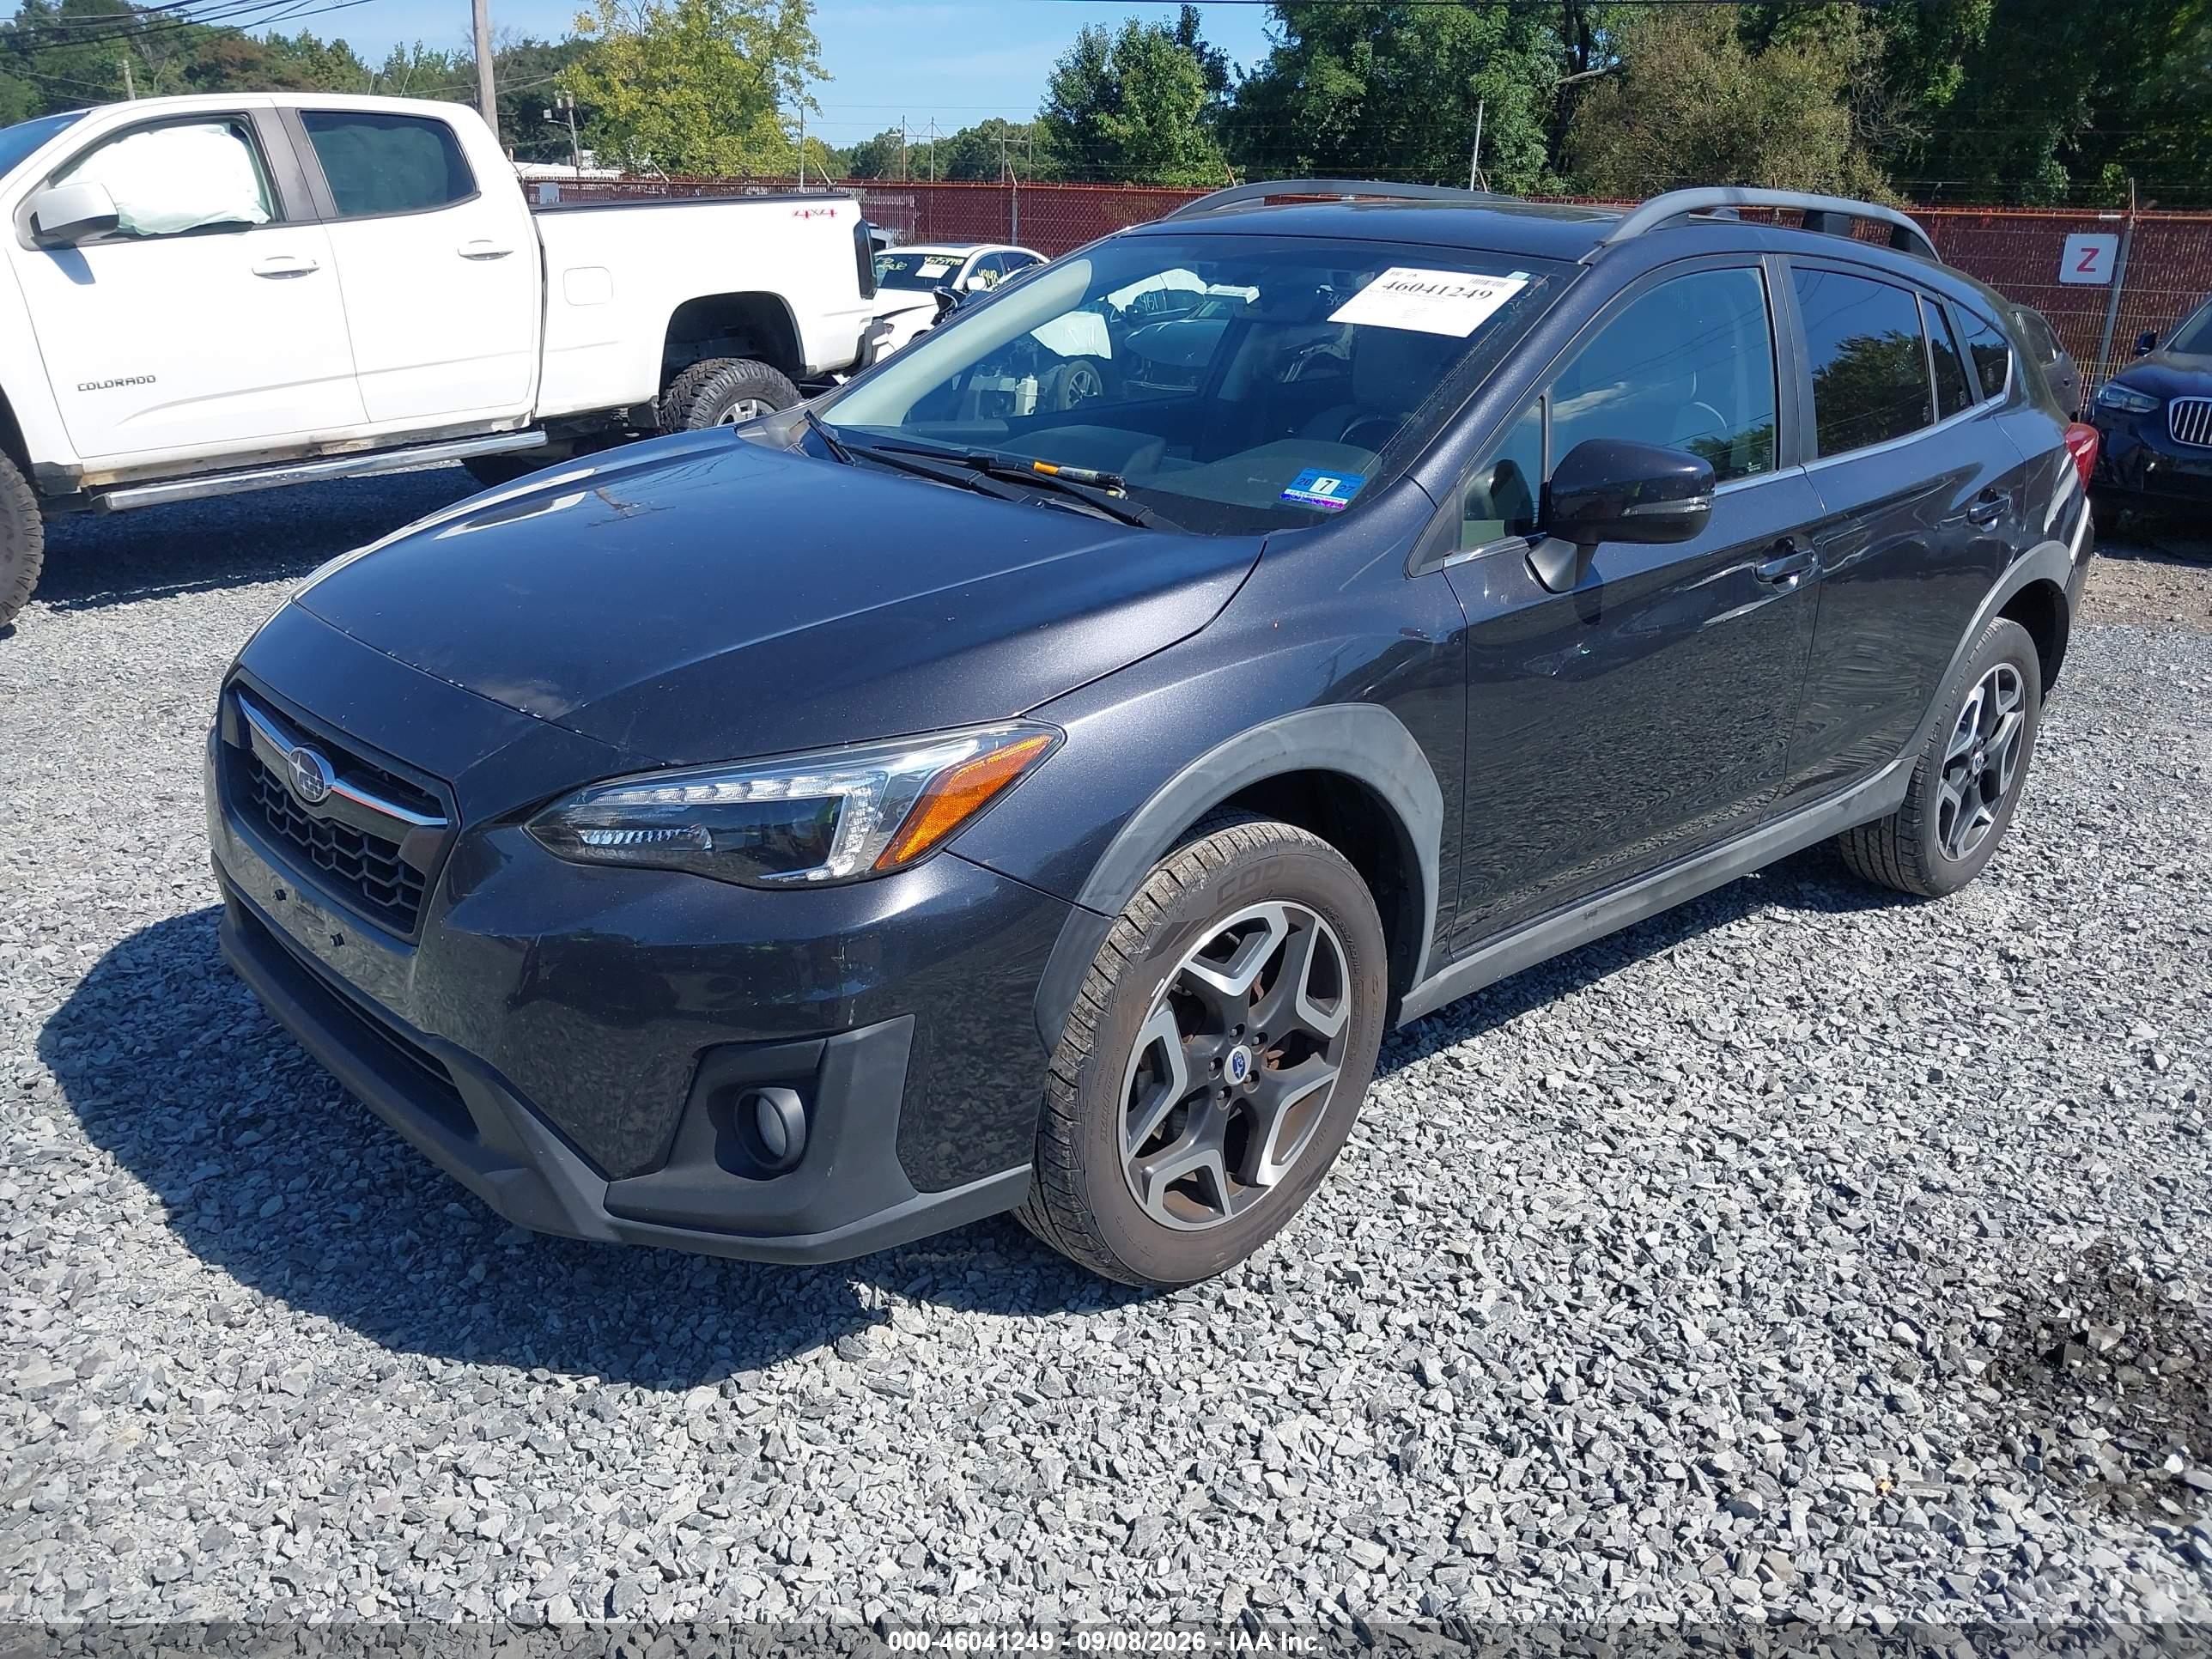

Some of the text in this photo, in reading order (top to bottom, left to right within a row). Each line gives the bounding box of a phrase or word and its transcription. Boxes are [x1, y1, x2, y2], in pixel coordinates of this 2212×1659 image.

[2076, 247, 2100, 273] Z
[1382, 279, 1494, 301] 46041249
[76, 374, 156, 392] COLORADO
[1319, 479, 1334, 492] 7
